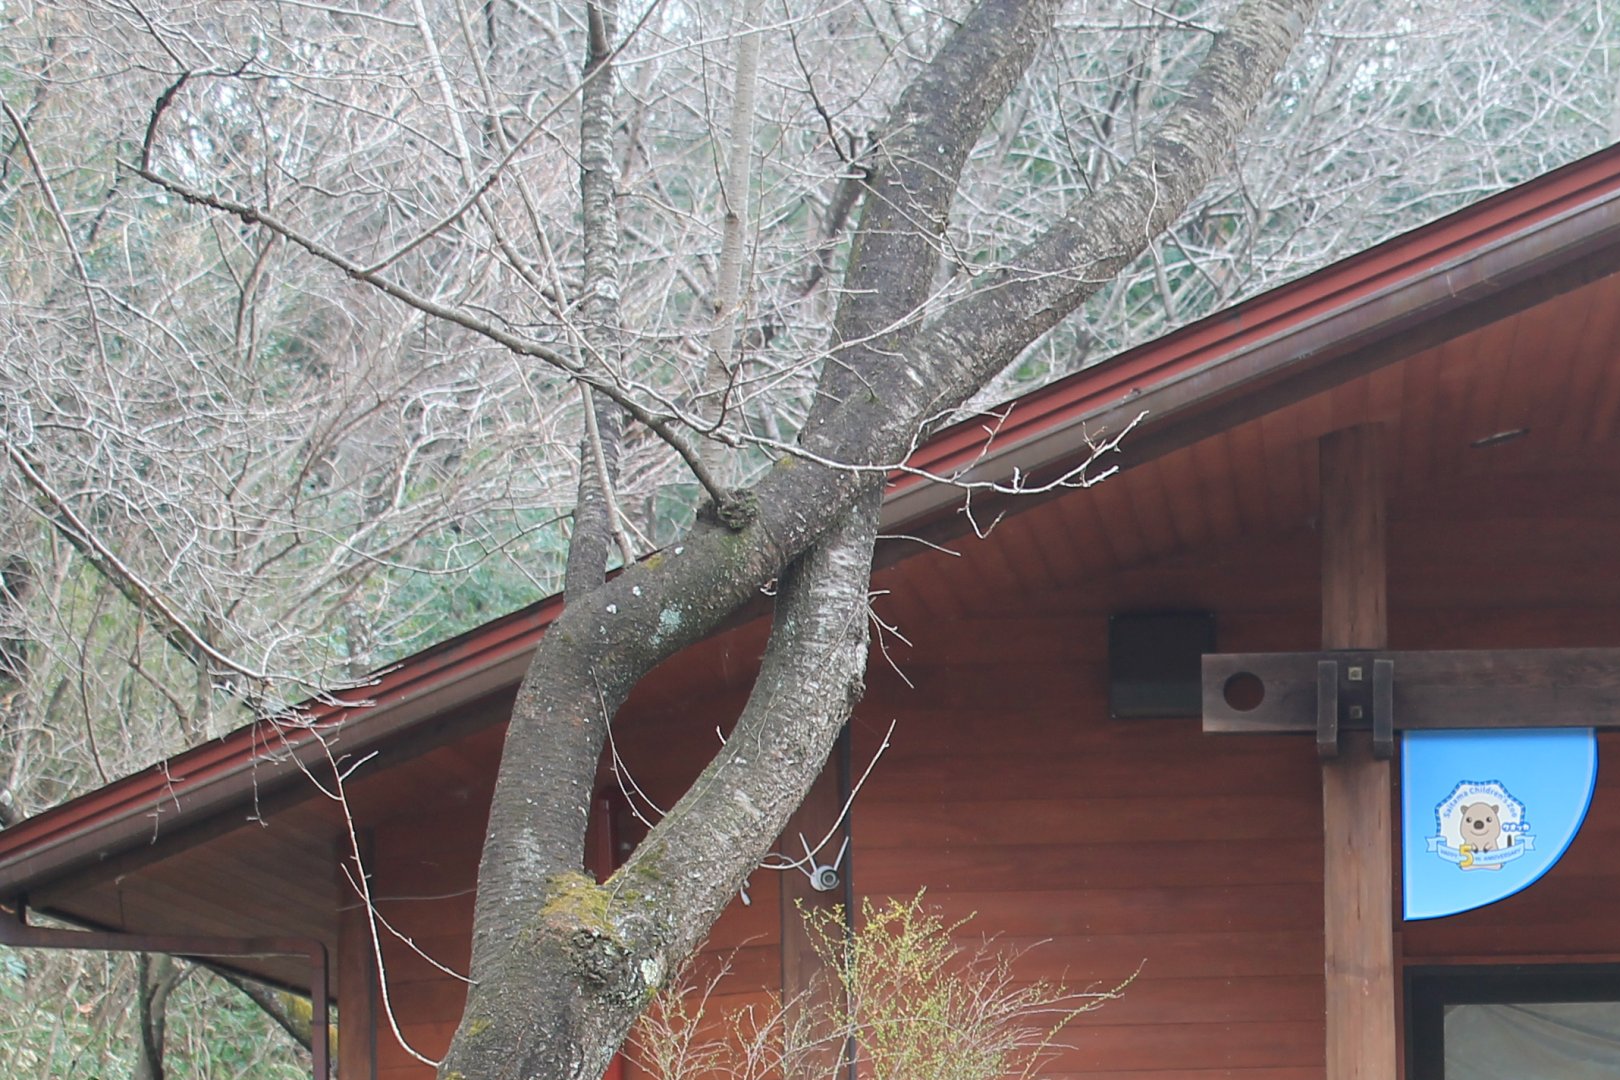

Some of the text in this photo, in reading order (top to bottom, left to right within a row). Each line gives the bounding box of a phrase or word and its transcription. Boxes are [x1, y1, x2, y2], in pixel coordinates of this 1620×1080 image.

[1443, 787, 1517, 818] Saitama Children's Zoo
